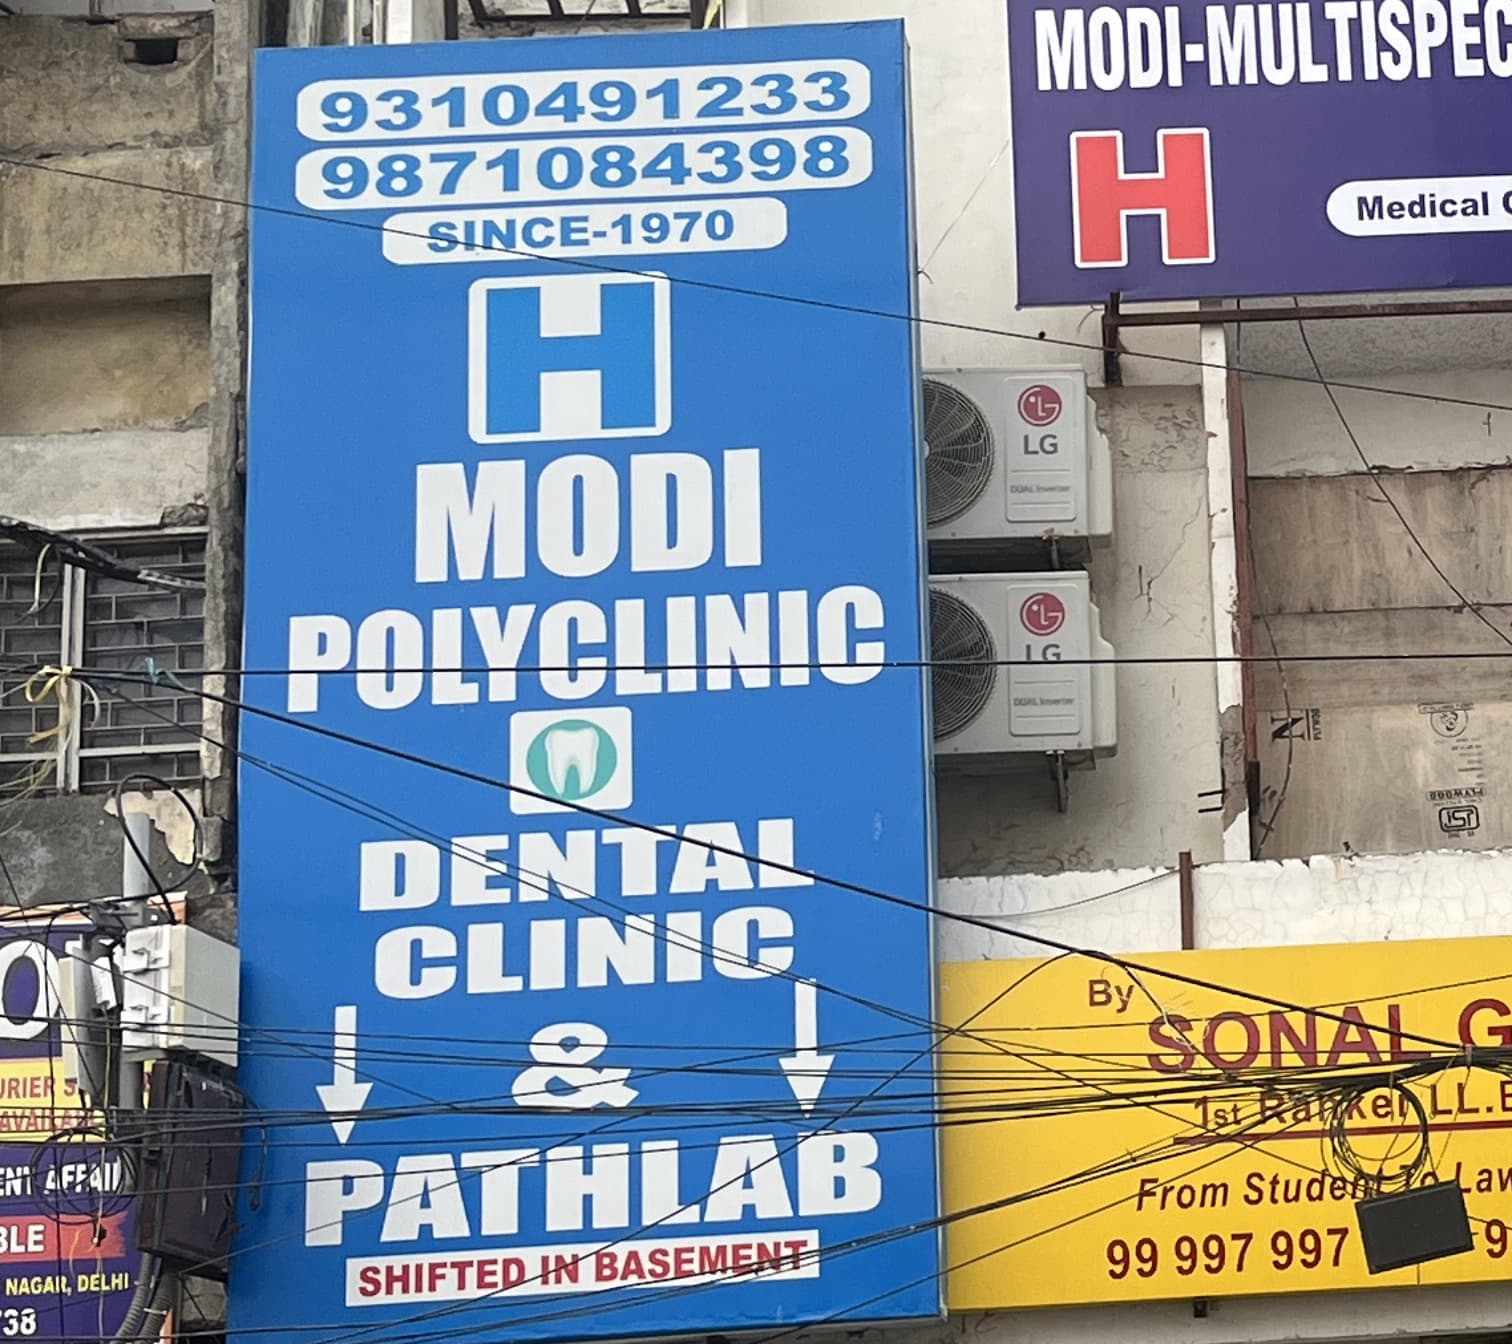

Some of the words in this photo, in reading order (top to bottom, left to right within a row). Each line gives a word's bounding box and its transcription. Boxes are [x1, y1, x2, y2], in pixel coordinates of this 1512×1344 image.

[319, 70, 852, 134] 9310491233
[320, 134, 851, 200] 9871084398
[426, 209, 736, 253] SINCE-1970
[1356, 179, 1493, 222] Medical
[1023, 434, 1059, 456] LG
[415, 447, 763, 584] MODI
[287, 584, 886, 714] POLYCLINIC
[359, 818, 815, 911] DENTAL
[374, 905, 795, 1000] CLINIC
[1088, 978, 1135, 1013] By
[511, 1021, 640, 1112] &
[1148, 1004, 1431, 1075] SONAL
[1194, 1096, 1243, 1129] 1st
[304, 1129, 883, 1248] PATHLAB
[1136, 1177, 1230, 1211] From
[1243, 1165, 1383, 1206] Student
[358, 1254, 527, 1298] SHIFTED
[541, 1251, 581, 1285] IN
[594, 1239, 809, 1283] BASEMENT
[1107, 1237, 1158, 1280] 99
[1175, 1232, 1254, 1276] 997
[1270, 1226, 1350, 1271] 997
[6, 1276, 72, 1296] NAGAR,
[77, 1272, 130, 1292] DELHI
